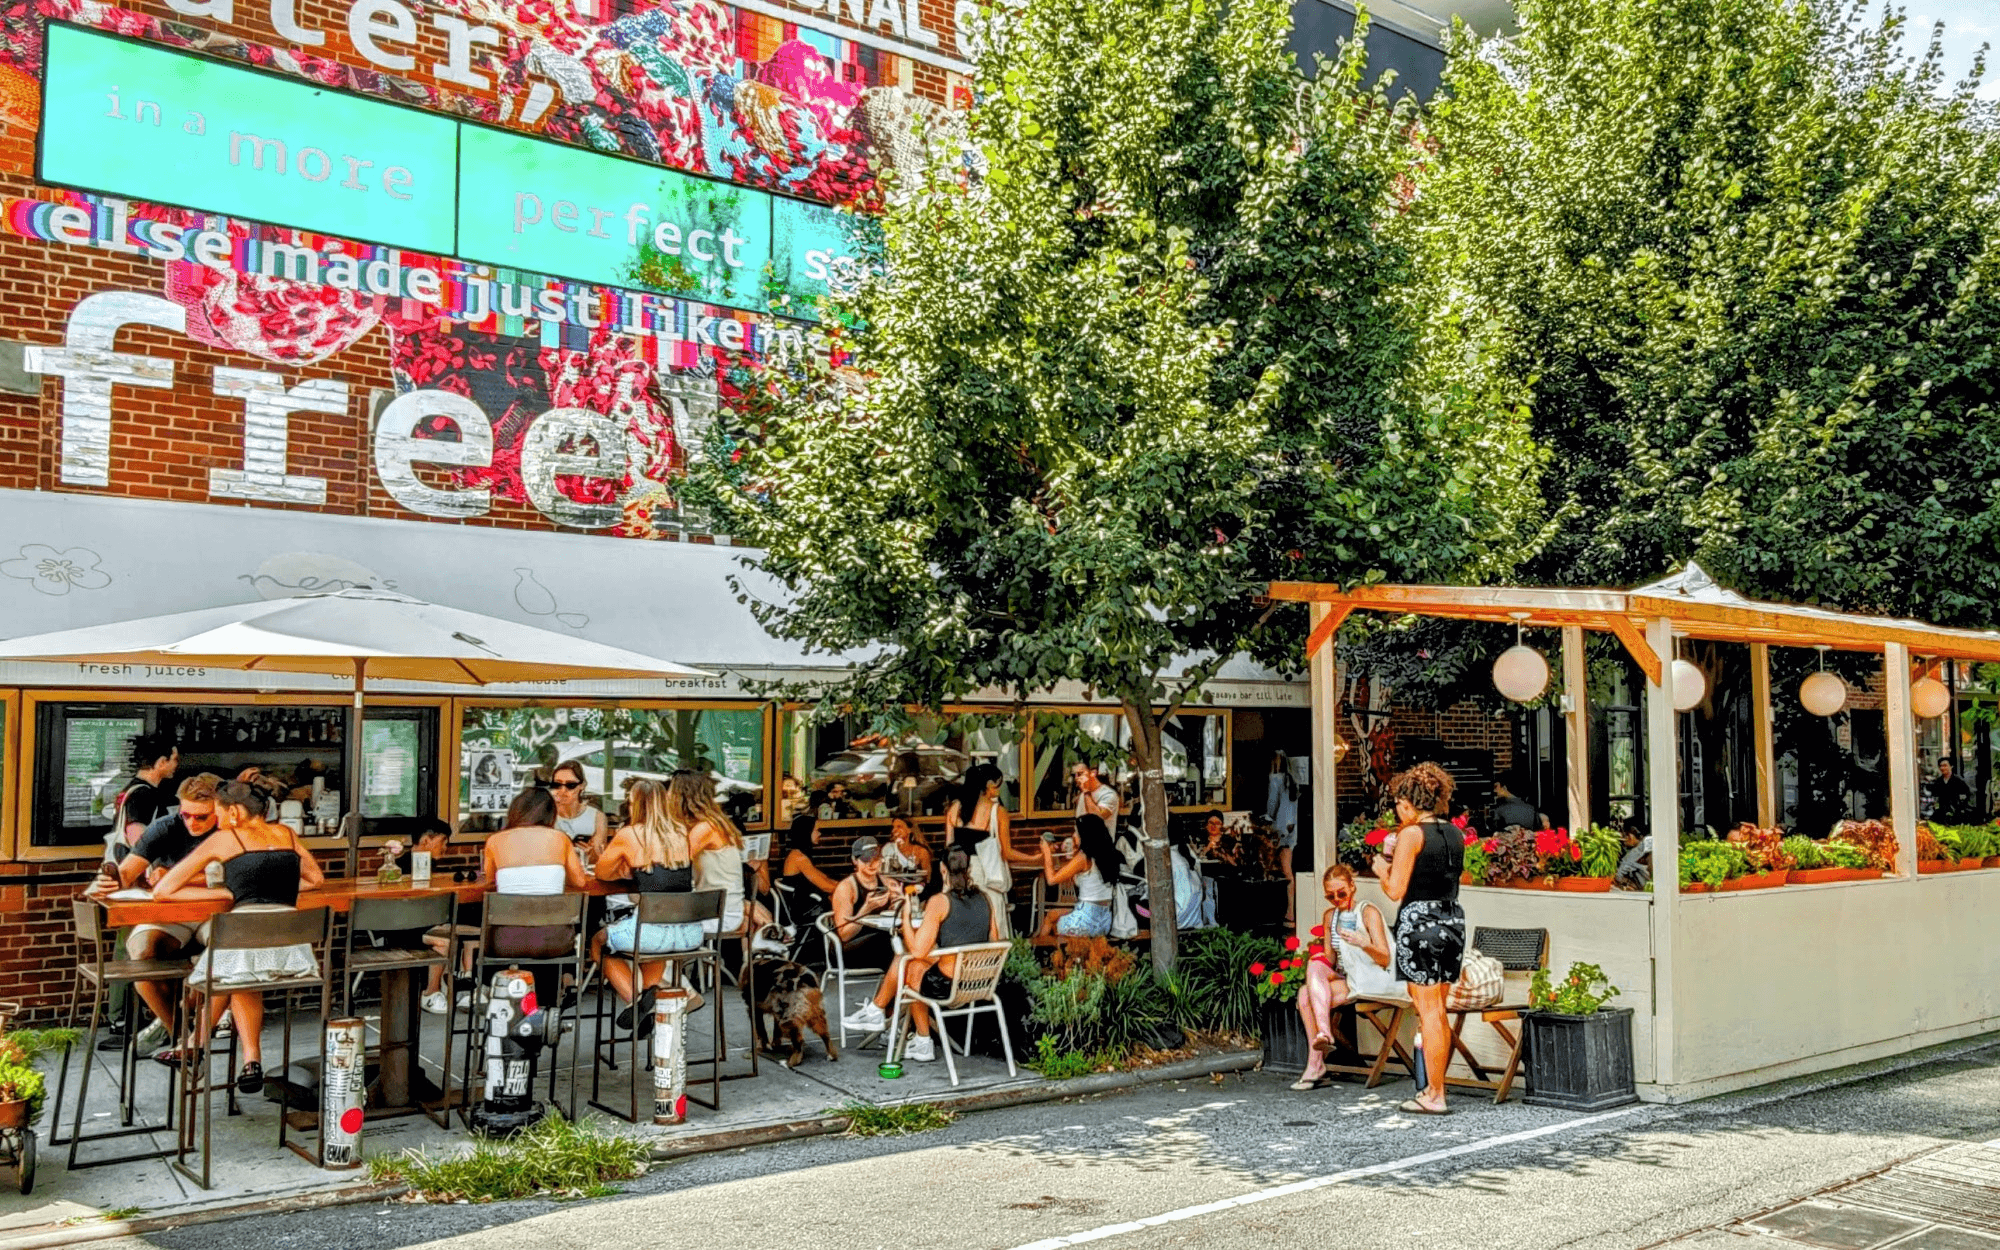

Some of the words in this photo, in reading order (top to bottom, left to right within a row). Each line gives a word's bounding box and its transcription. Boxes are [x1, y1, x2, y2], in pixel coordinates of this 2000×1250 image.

[103, 85, 162, 127] in
[183, 110, 206, 136] a
[229, 130, 414, 200] more
[513, 190, 745, 267] perfect
[48, 198, 232, 269] else
[260, 239, 441, 302] made
[463, 266, 600, 328] just
[622, 291, 744, 349] like
[78, 662, 132, 674] fresh
[145, 664, 206, 677] juices
[665, 677, 728, 688] breakfast
[1240, 691, 1252, 699] bar
